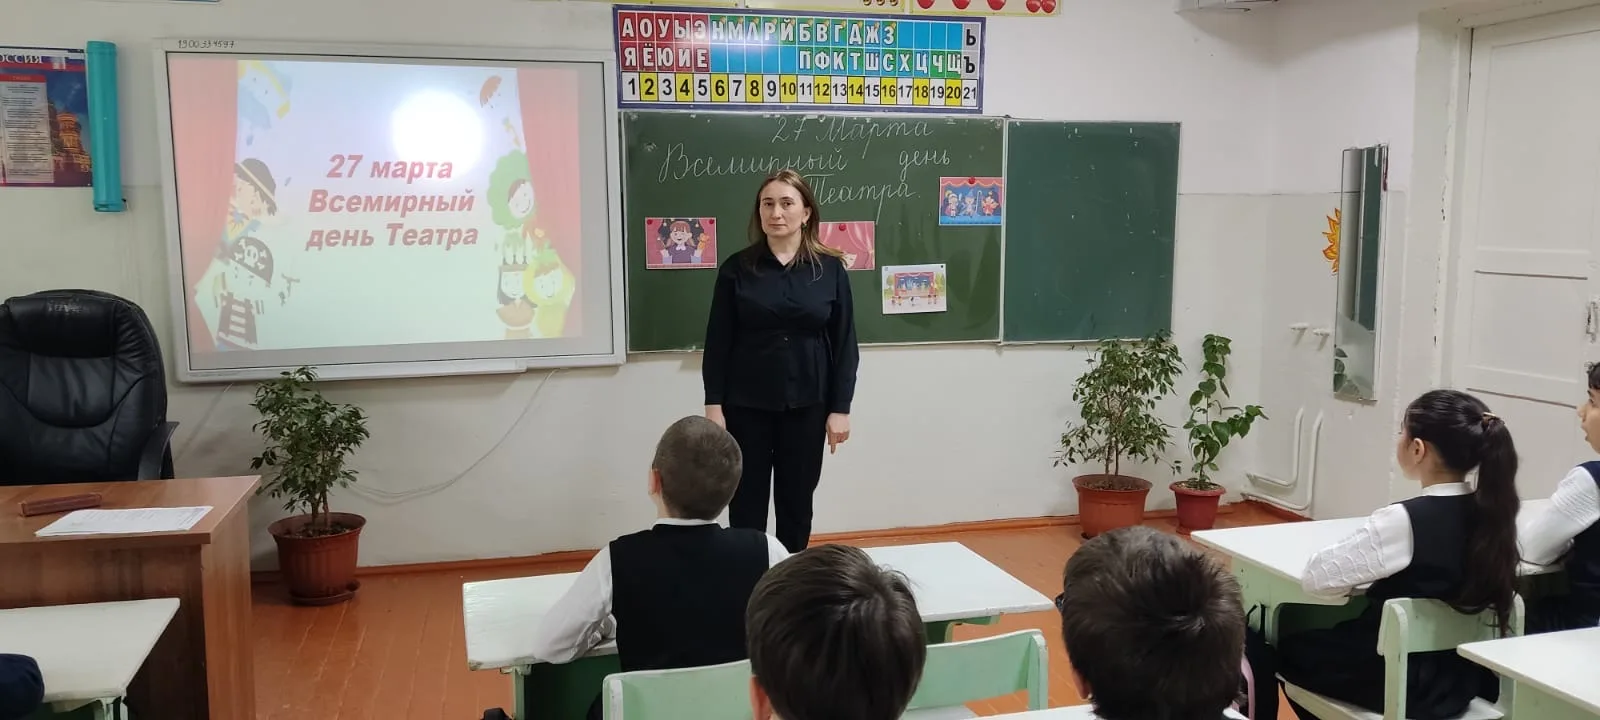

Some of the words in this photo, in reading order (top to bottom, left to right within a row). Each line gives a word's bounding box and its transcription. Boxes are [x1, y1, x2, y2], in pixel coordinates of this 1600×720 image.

[628, 78, 635, 95] 1
[645, 78, 654, 95] 2
[663, 79, 672, 95] 3
[680, 79, 690, 95] 4
[698, 79, 707, 96] 5
[715, 80, 725, 96] 6
[733, 80, 742, 96] 7
[750, 80, 759, 96] 8
[767, 81, 776, 96] 9
[781, 82, 796, 96] 10
[800, 83, 812, 95] 11
[815, 83, 829, 96] 12
[833, 84, 847, 97] 13
[849, 84, 863, 97] 14
[866, 85, 879, 97] 15
[881, 85, 896, 98] 16
[898, 85, 912, 98] 17
[914, 85, 928, 98] 18
[930, 86, 944, 98] 19
[946, 86, 961, 99] 20
[963, 86, 976, 99] 21
[772, 118, 809, 143] 27
[816, 116, 933, 158] Марта
[327, 154, 363, 178] 27
[370, 161, 453, 184] марта
[899, 150, 950, 180] день
[309, 189, 475, 217] Всемирный
[305, 229, 374, 251] день
[386, 223, 478, 251] Театра
